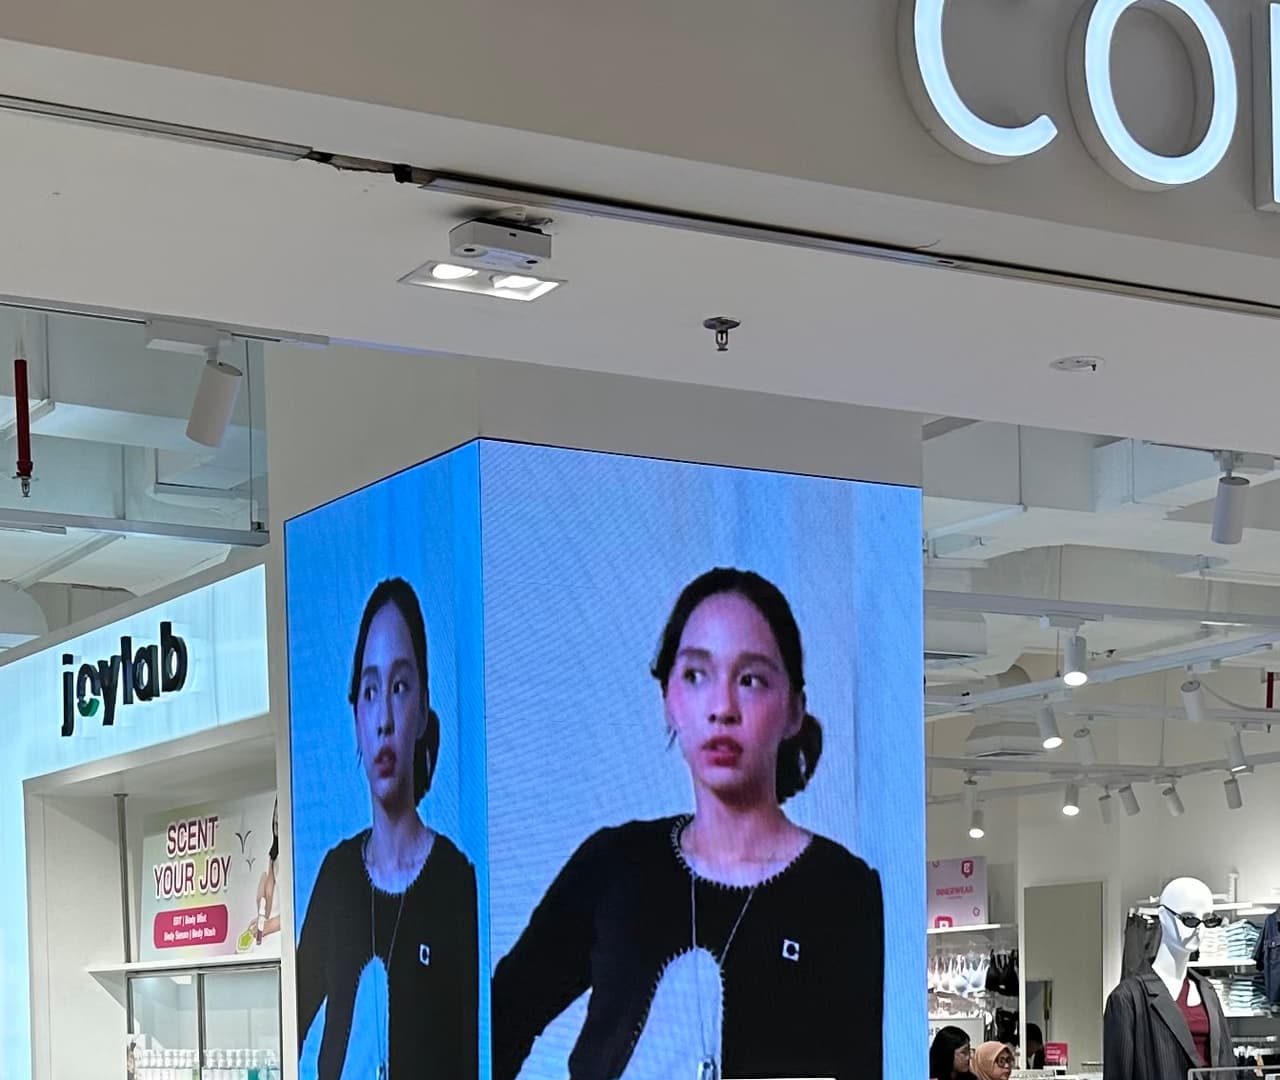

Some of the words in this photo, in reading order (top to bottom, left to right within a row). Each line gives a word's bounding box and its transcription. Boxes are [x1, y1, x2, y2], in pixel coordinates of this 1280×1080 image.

[61, 621, 188, 737] joylab
[166, 815, 219, 856] SCENT
[153, 862, 195, 898] YOUR
[199, 855, 232, 891] JOY
